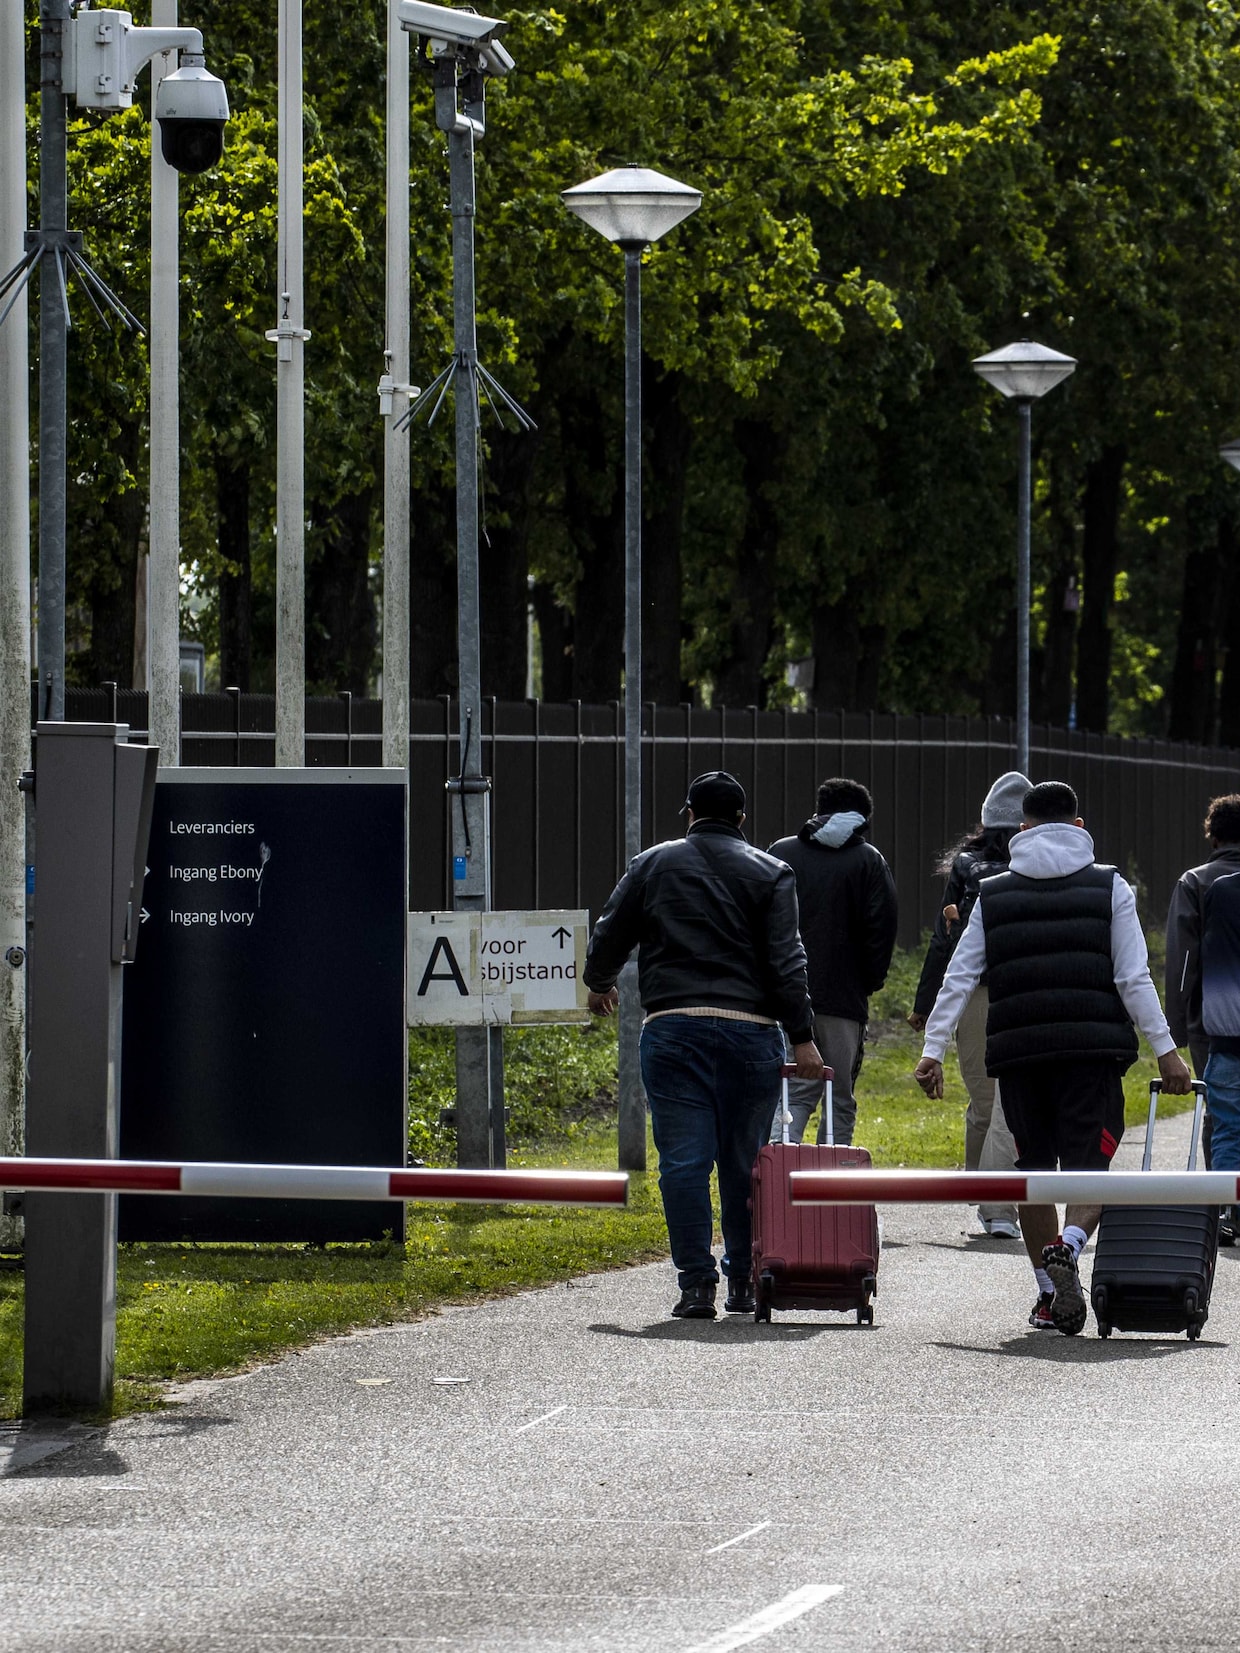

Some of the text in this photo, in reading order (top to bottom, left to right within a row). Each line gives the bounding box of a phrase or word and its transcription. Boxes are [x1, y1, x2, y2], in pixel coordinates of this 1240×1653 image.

[170, 820, 256, 834] Leveranciers
[170, 864, 263, 882] Ingang Ebony
[170, 909, 255, 926] Ingang Ivory
[417, 936, 469, 996] A
